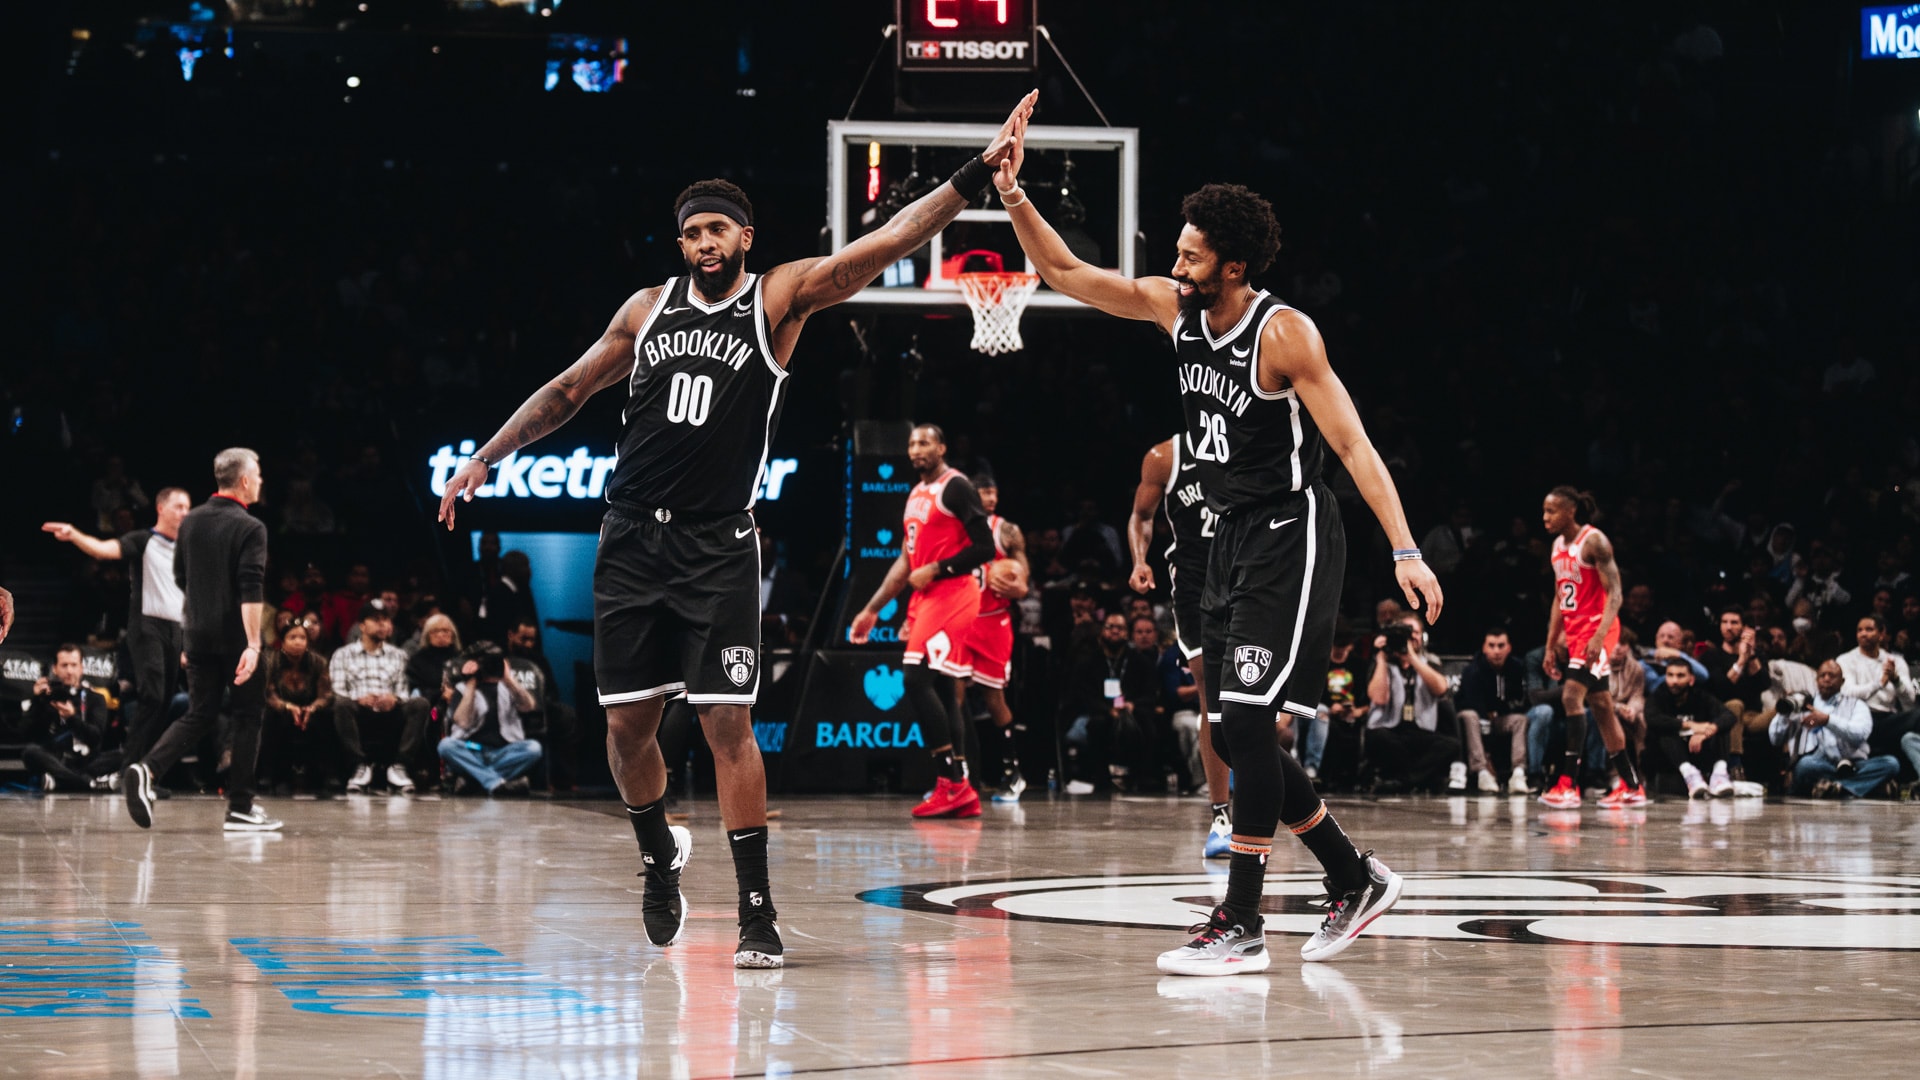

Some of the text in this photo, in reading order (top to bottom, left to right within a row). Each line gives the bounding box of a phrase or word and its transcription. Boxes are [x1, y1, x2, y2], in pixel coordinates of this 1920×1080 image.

[940, 41, 1029, 59] TISSOT
[644, 329, 754, 372] BROOKLYN
[667, 372, 713, 427] 00
[1195, 410, 1230, 464] 26
[861, 482, 911, 493] BARCLAYS
[724, 649, 754, 666] NETS
[1236, 648, 1270, 667] NETS
[816, 722, 925, 747] BARCLA
